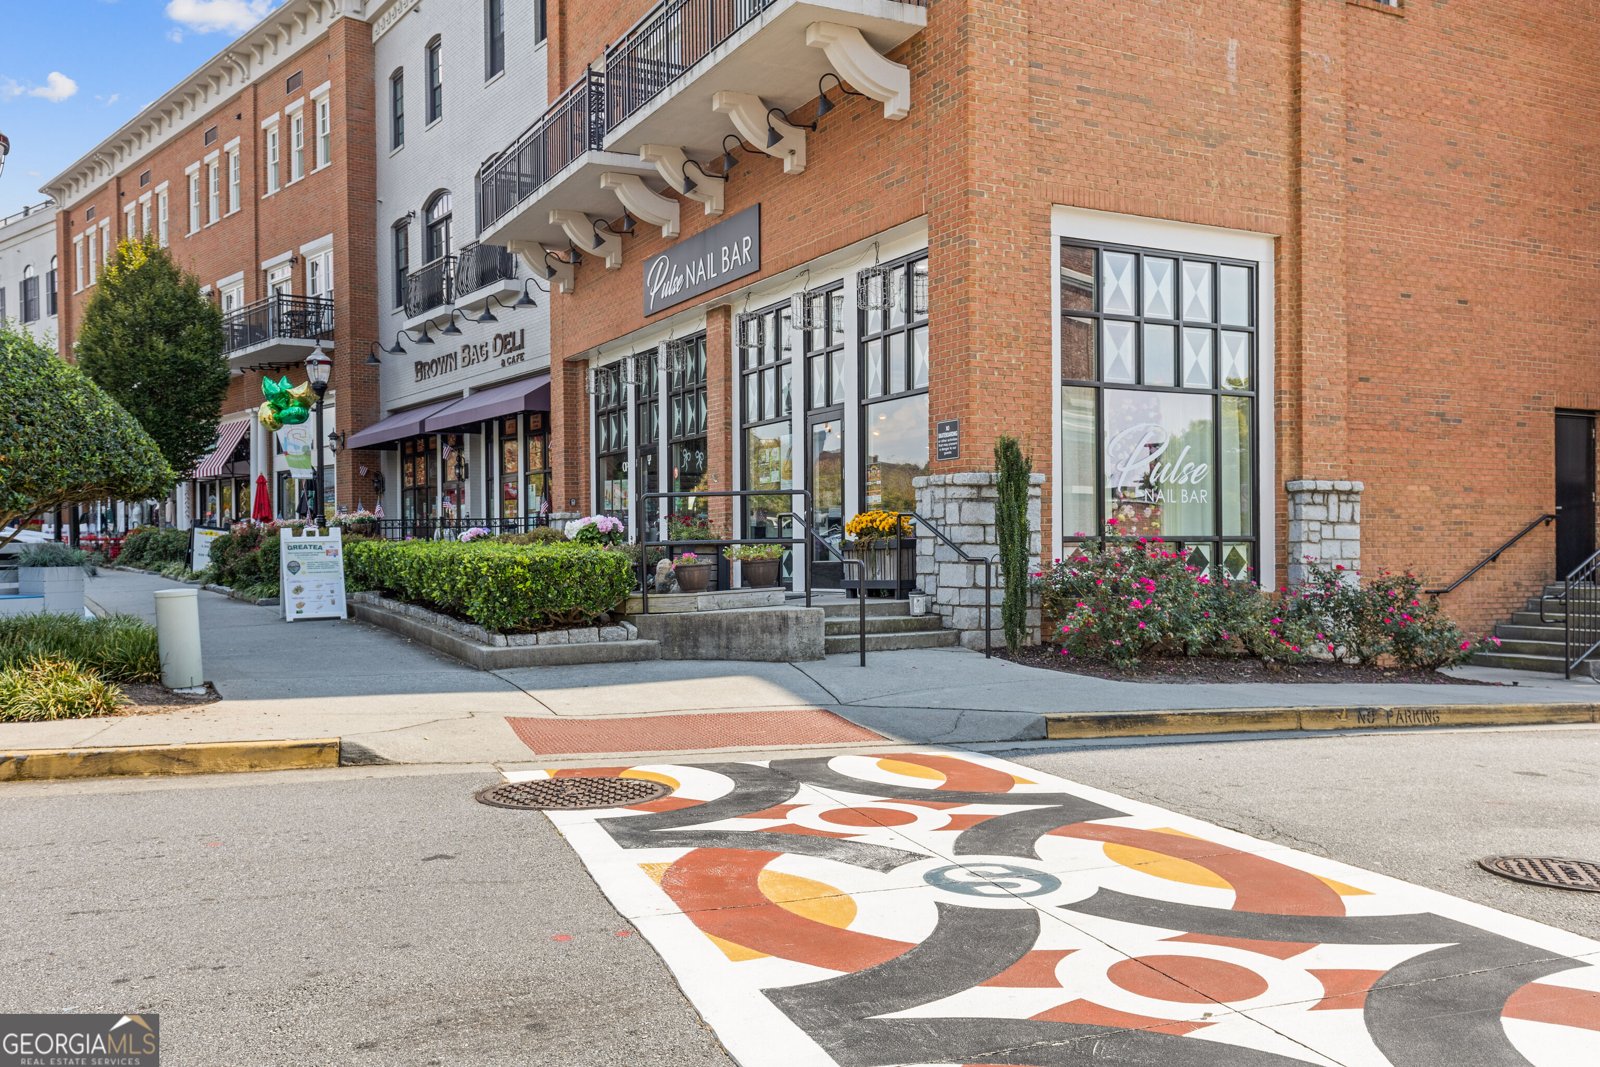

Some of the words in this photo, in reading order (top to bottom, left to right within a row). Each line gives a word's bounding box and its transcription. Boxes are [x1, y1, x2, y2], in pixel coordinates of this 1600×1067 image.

[647, 255, 685, 310] Pulse
[685, 252, 717, 289] NAIL
[721, 235, 752, 273] BAR
[414, 351, 458, 383] BROWN
[461, 341, 489, 368] BAG
[493, 328, 525, 358] DELI
[1108, 423, 1209, 493] Pulse
[1144, 489, 1177, 504] NAIL
[1181, 489, 1208, 504] BAR
[1357, 708, 1375, 724] NO
[1386, 709, 1440, 724] PARKING
